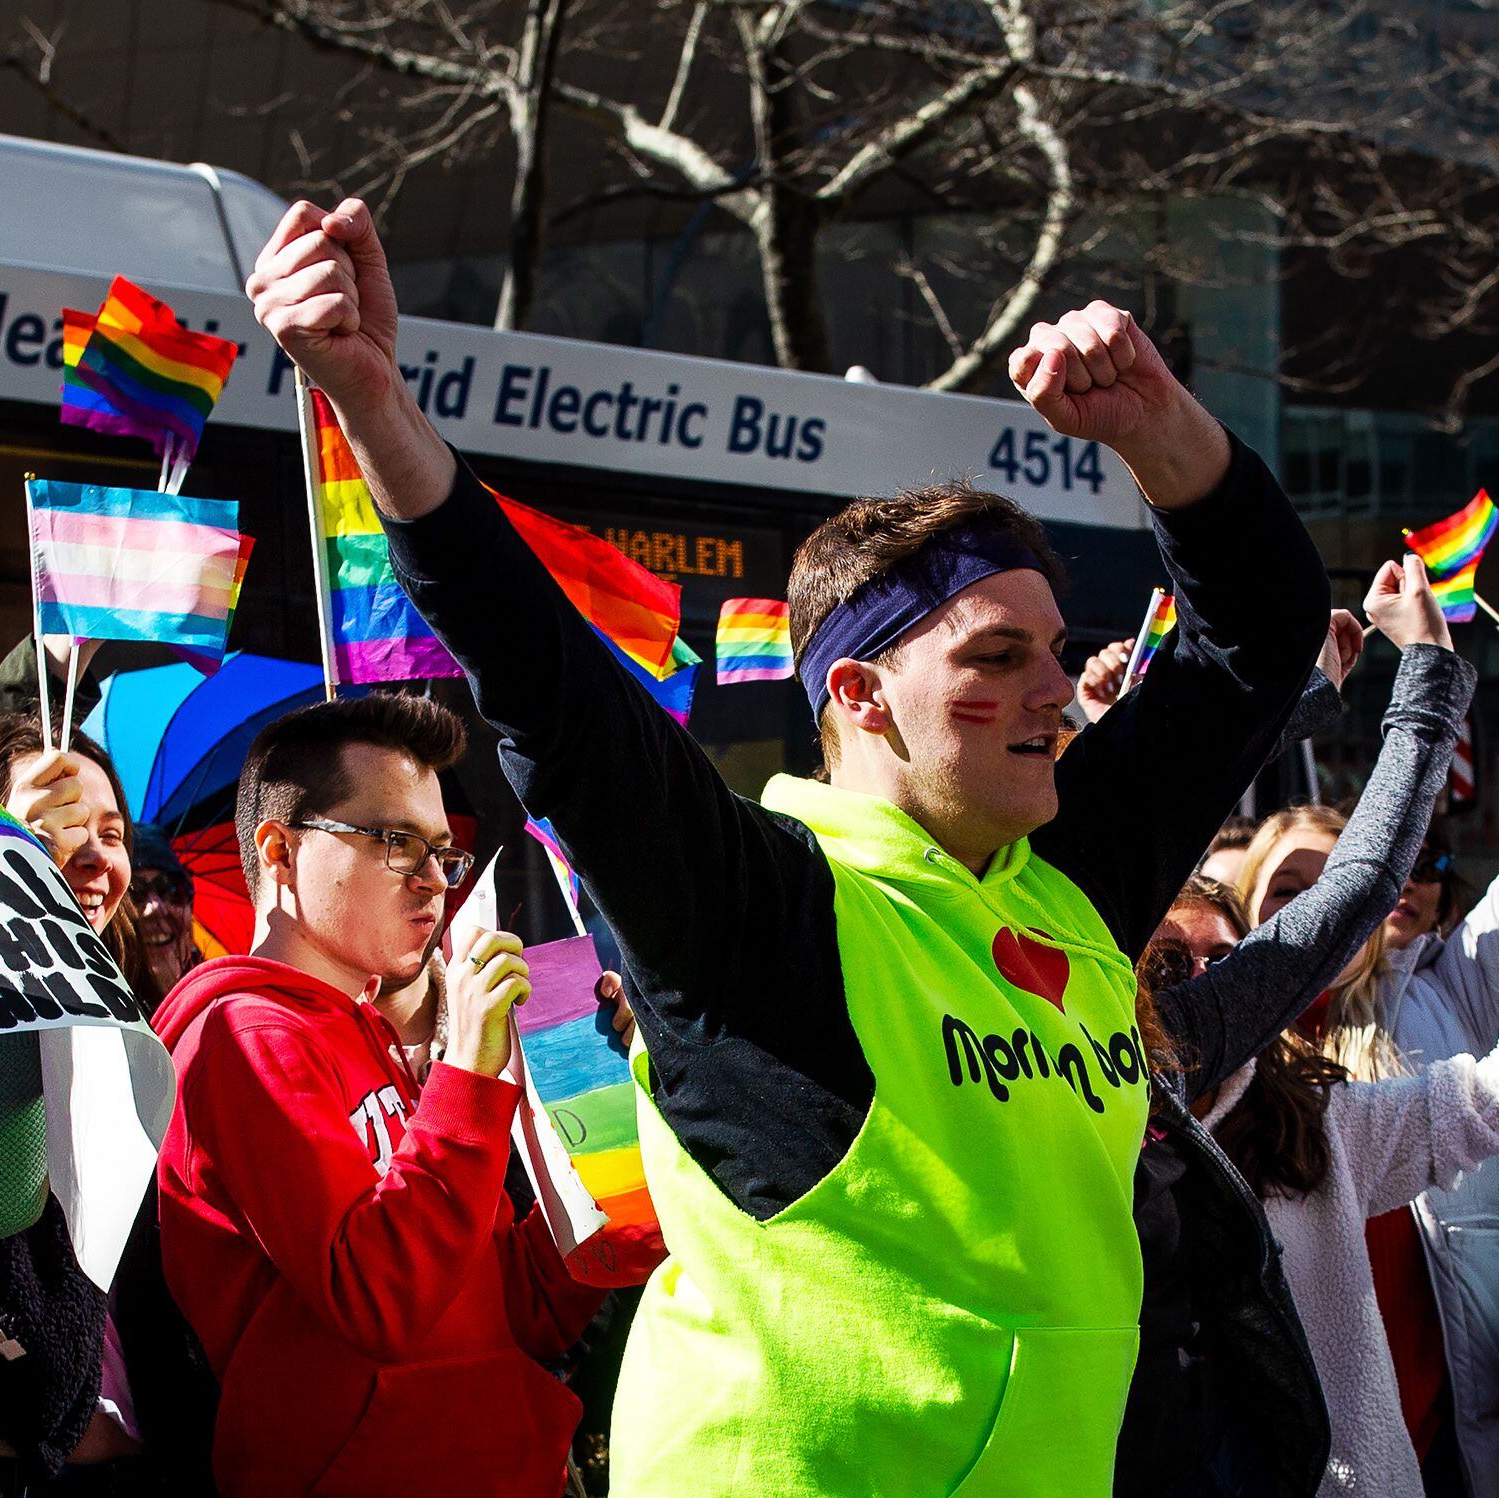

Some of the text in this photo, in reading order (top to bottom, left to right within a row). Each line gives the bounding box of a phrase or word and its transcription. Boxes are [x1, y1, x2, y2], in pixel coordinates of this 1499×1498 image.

[493, 362, 708, 449] Electric
[727, 394, 827, 464] Bus
[989, 427, 1106, 495] 4514
[605, 527, 744, 579] HARLEM
